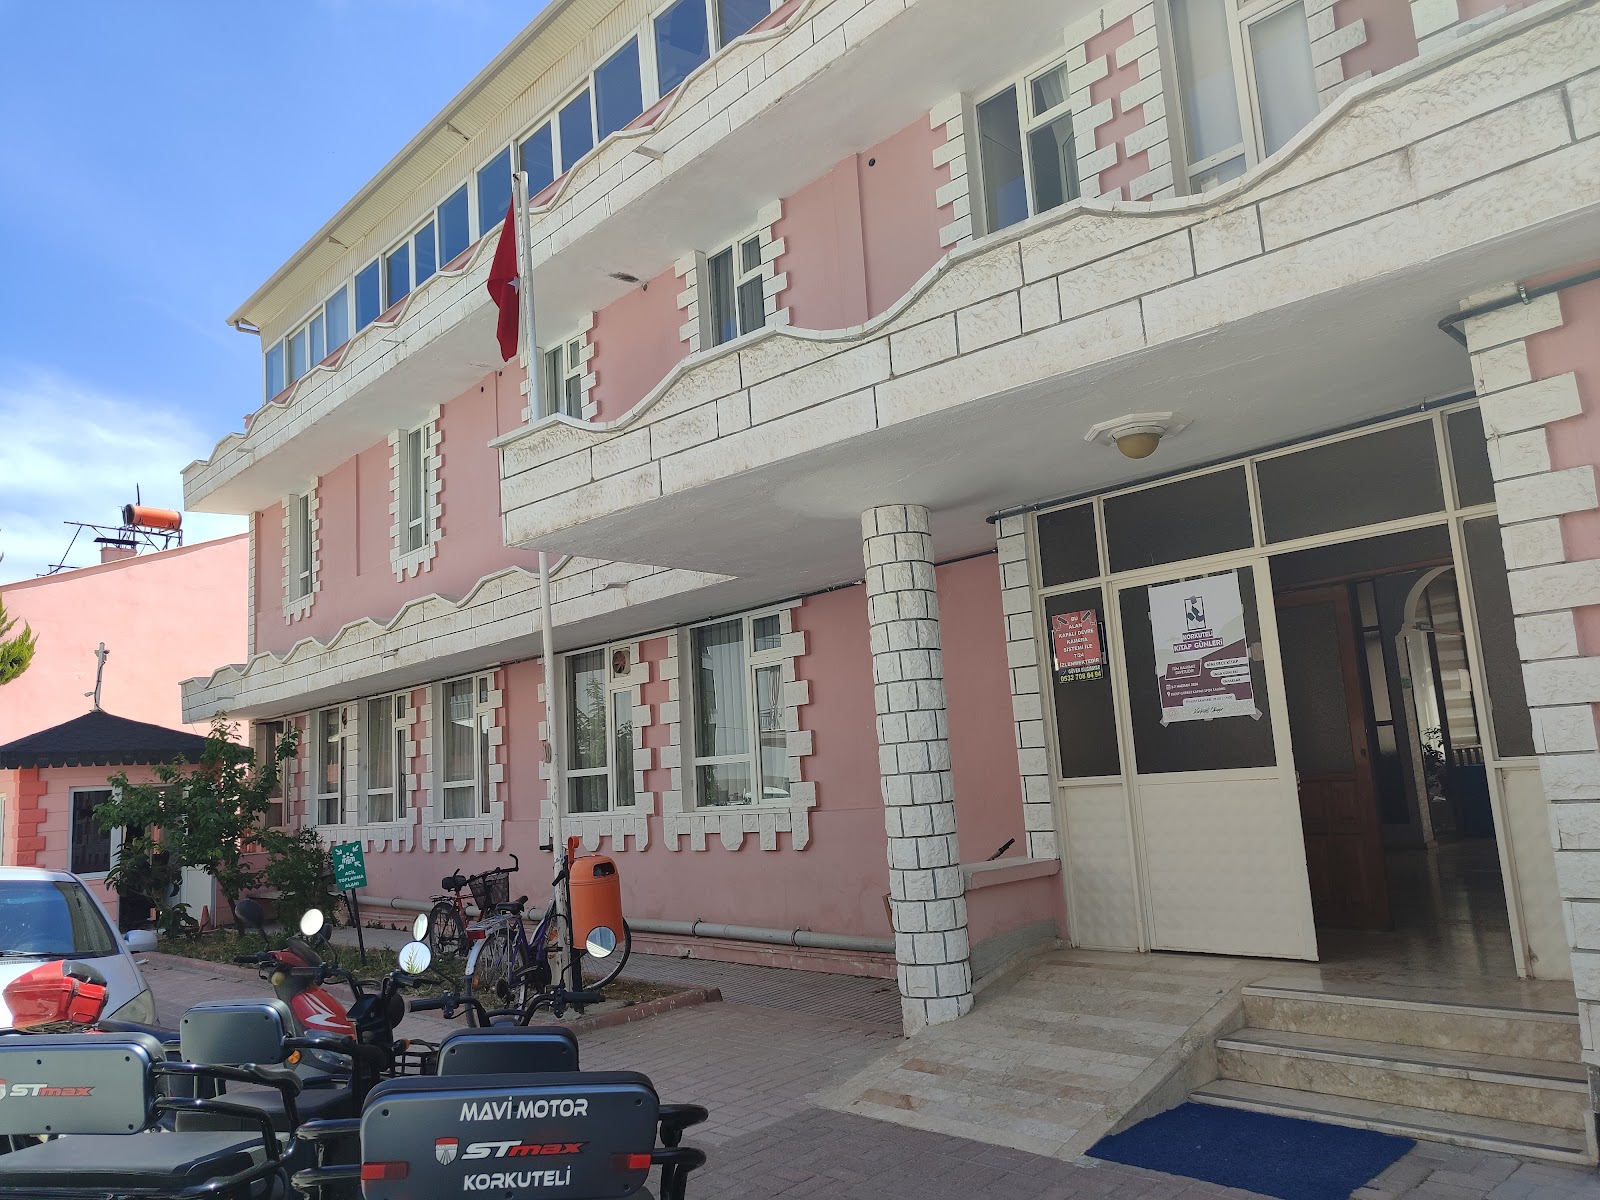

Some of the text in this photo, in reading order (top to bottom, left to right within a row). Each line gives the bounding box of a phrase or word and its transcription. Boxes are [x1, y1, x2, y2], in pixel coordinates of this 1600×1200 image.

[1183, 630, 1213, 641] KORKUTELİ
[1174, 638, 1223, 652] KİTAP GÜNLERİ
[1060, 674, 1075, 682] 0532
[338, 874, 364, 883] TOPLANMA
[9, 1083, 96, 1097] STmax
[459, 1095, 589, 1122] MAVİ MOTOR
[460, 1140, 588, 1160] STmax
[463, 1165, 571, 1191] KORKUTELİ
